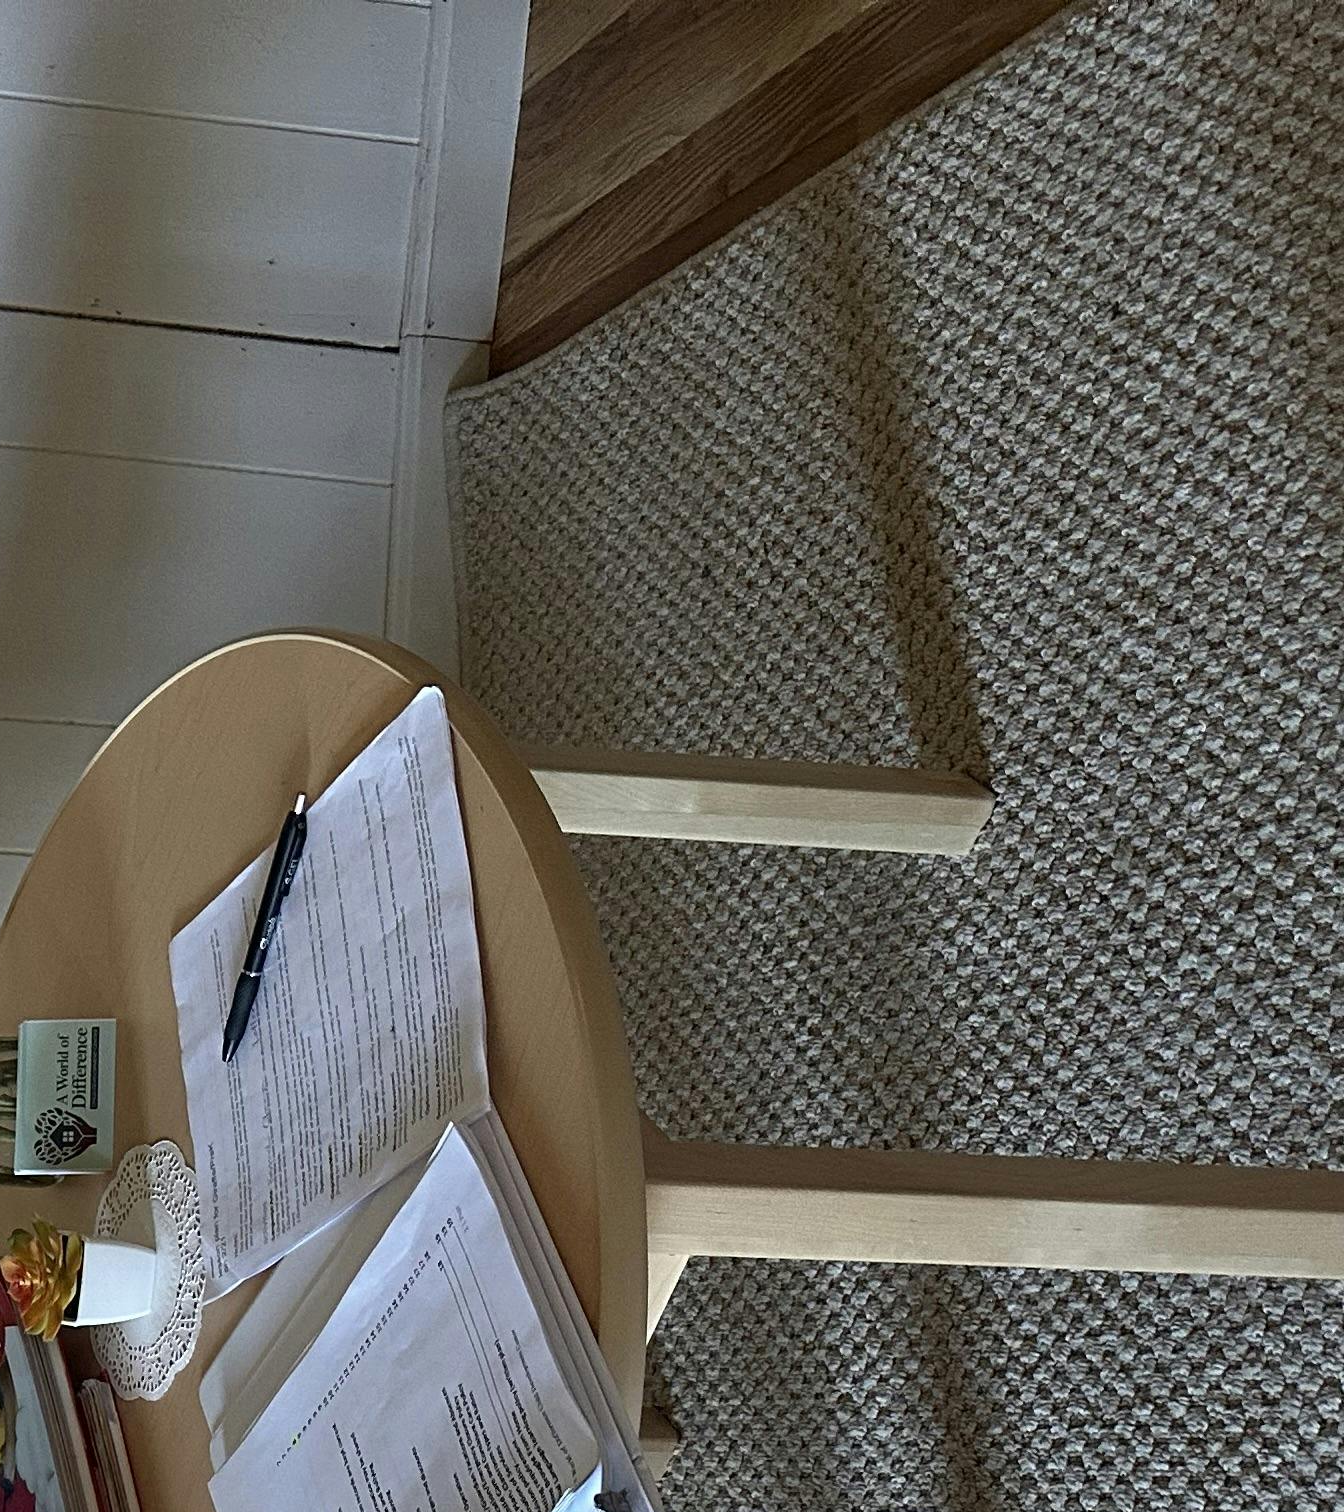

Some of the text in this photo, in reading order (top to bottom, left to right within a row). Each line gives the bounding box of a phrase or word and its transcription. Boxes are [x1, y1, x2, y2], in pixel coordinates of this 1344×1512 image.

[56, 1033, 69, 1105] A World of
[72, 1027, 87, 1108] Difference
